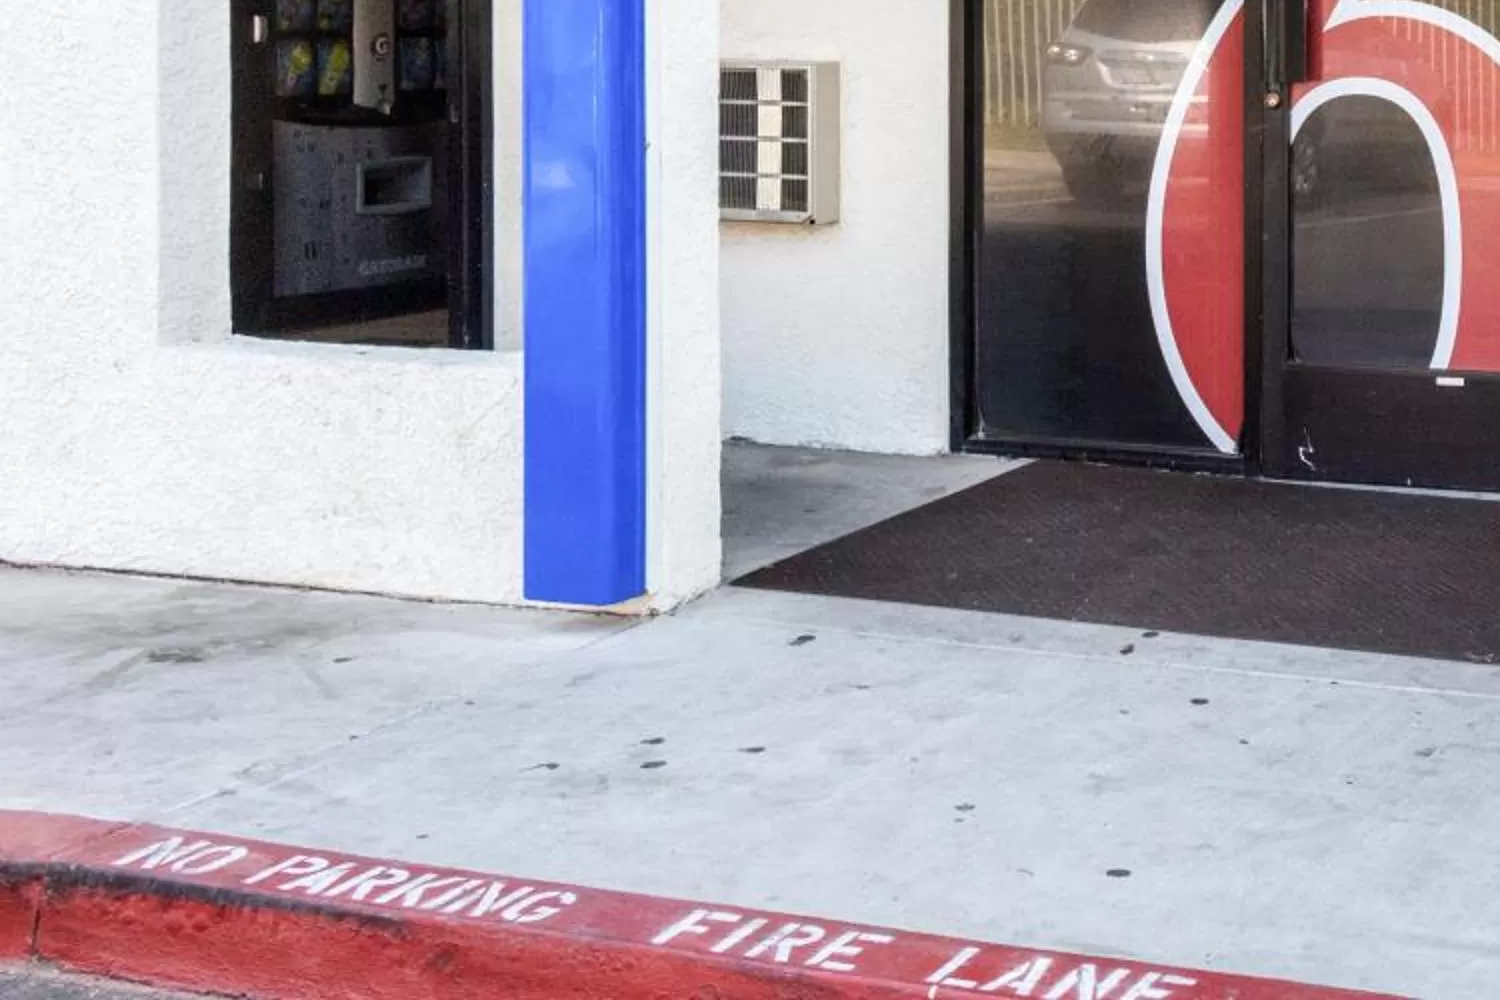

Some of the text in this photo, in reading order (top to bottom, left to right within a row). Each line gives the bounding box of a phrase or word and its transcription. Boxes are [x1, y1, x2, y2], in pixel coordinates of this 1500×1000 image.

[111, 836, 249, 875] NO
[241, 855, 577, 923] PARKING
[651, 909, 893, 972] FIRE
